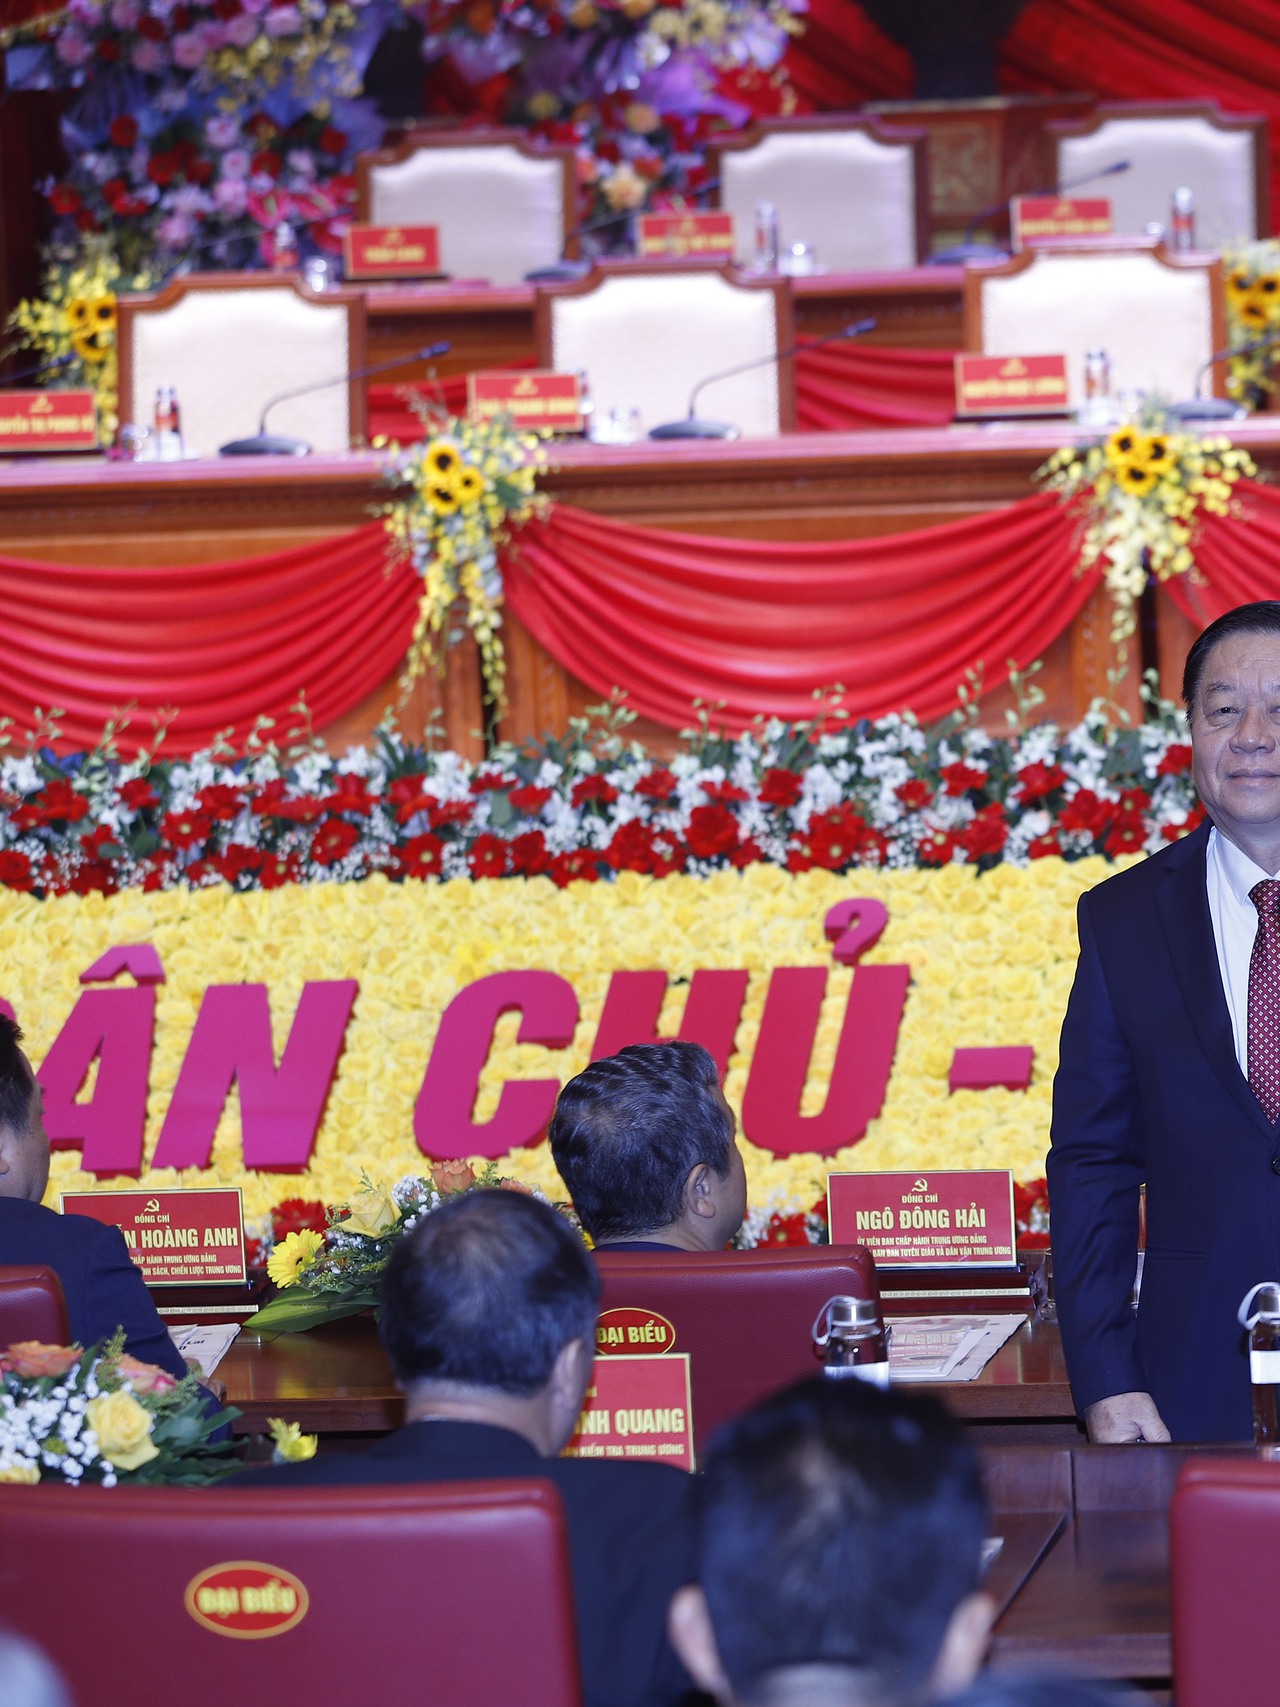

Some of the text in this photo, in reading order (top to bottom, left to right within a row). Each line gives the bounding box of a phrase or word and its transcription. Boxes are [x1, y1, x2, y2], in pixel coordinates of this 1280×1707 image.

[0, 943, 359, 1180] ÂN
[925, 1193, 938, 1203] CHÍ
[157, 1214, 170, 1223] CHÍ
[856, 1202, 986, 1230] NGÔ ĐÔNG HẢI
[142, 1225, 199, 1248] HOÀNG
[203, 1227, 239, 1247] ANH
[881, 1236, 894, 1245] BAN
[895, 1234, 911, 1245] CHẤP
[912, 1235, 930, 1245] HÀNH
[931, 1235, 951, 1244] TRUNG
[952, 1235, 969, 1244] ƯƠNG
[872, 1249, 886, 1258] BAN
[886, 1248, 900, 1257] BAN
[900, 1247, 920, 1257] TUYÊN
[973, 1247, 994, 1256] TRUNG
[994, 1245, 1011, 1255] ƯƠNG
[147, 1254, 163, 1265] HÀNH
[163, 1255, 183, 1264] TRUNG
[183, 1254, 200, 1264] ƯƠNG
[205, 1265, 225, 1274] TRUNG
[225, 1264, 242, 1274] ƯƠNG
[596, 1320, 667, 1347] ĐẠI BIỂU
[615, 1408, 685, 1437] QUANG
[606, 1445, 624, 1456] TRA
[625, 1444, 657, 1456] TRUNG
[657, 1442, 685, 1456] ƯƠNG
